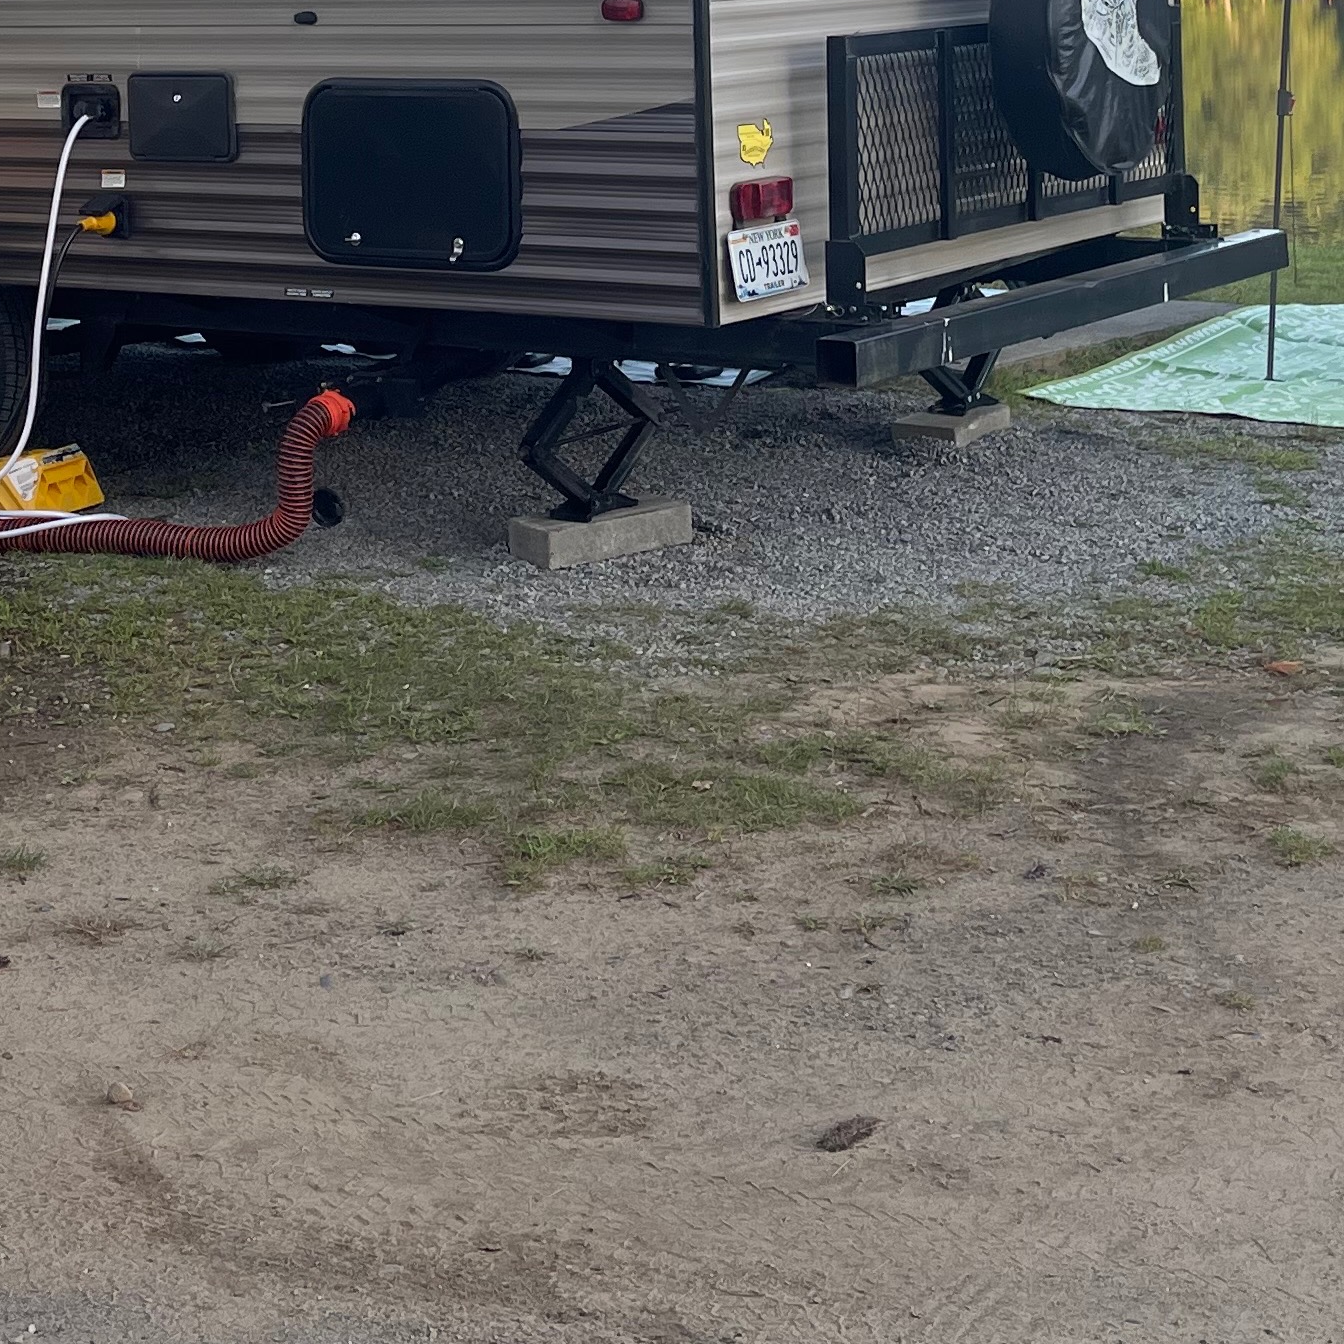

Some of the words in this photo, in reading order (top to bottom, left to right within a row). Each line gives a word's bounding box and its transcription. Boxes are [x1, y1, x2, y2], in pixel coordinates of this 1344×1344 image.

[748, 231, 764, 244] NEW
[765, 228, 784, 241] YORK
[764, 279, 785, 290] TRAILER
